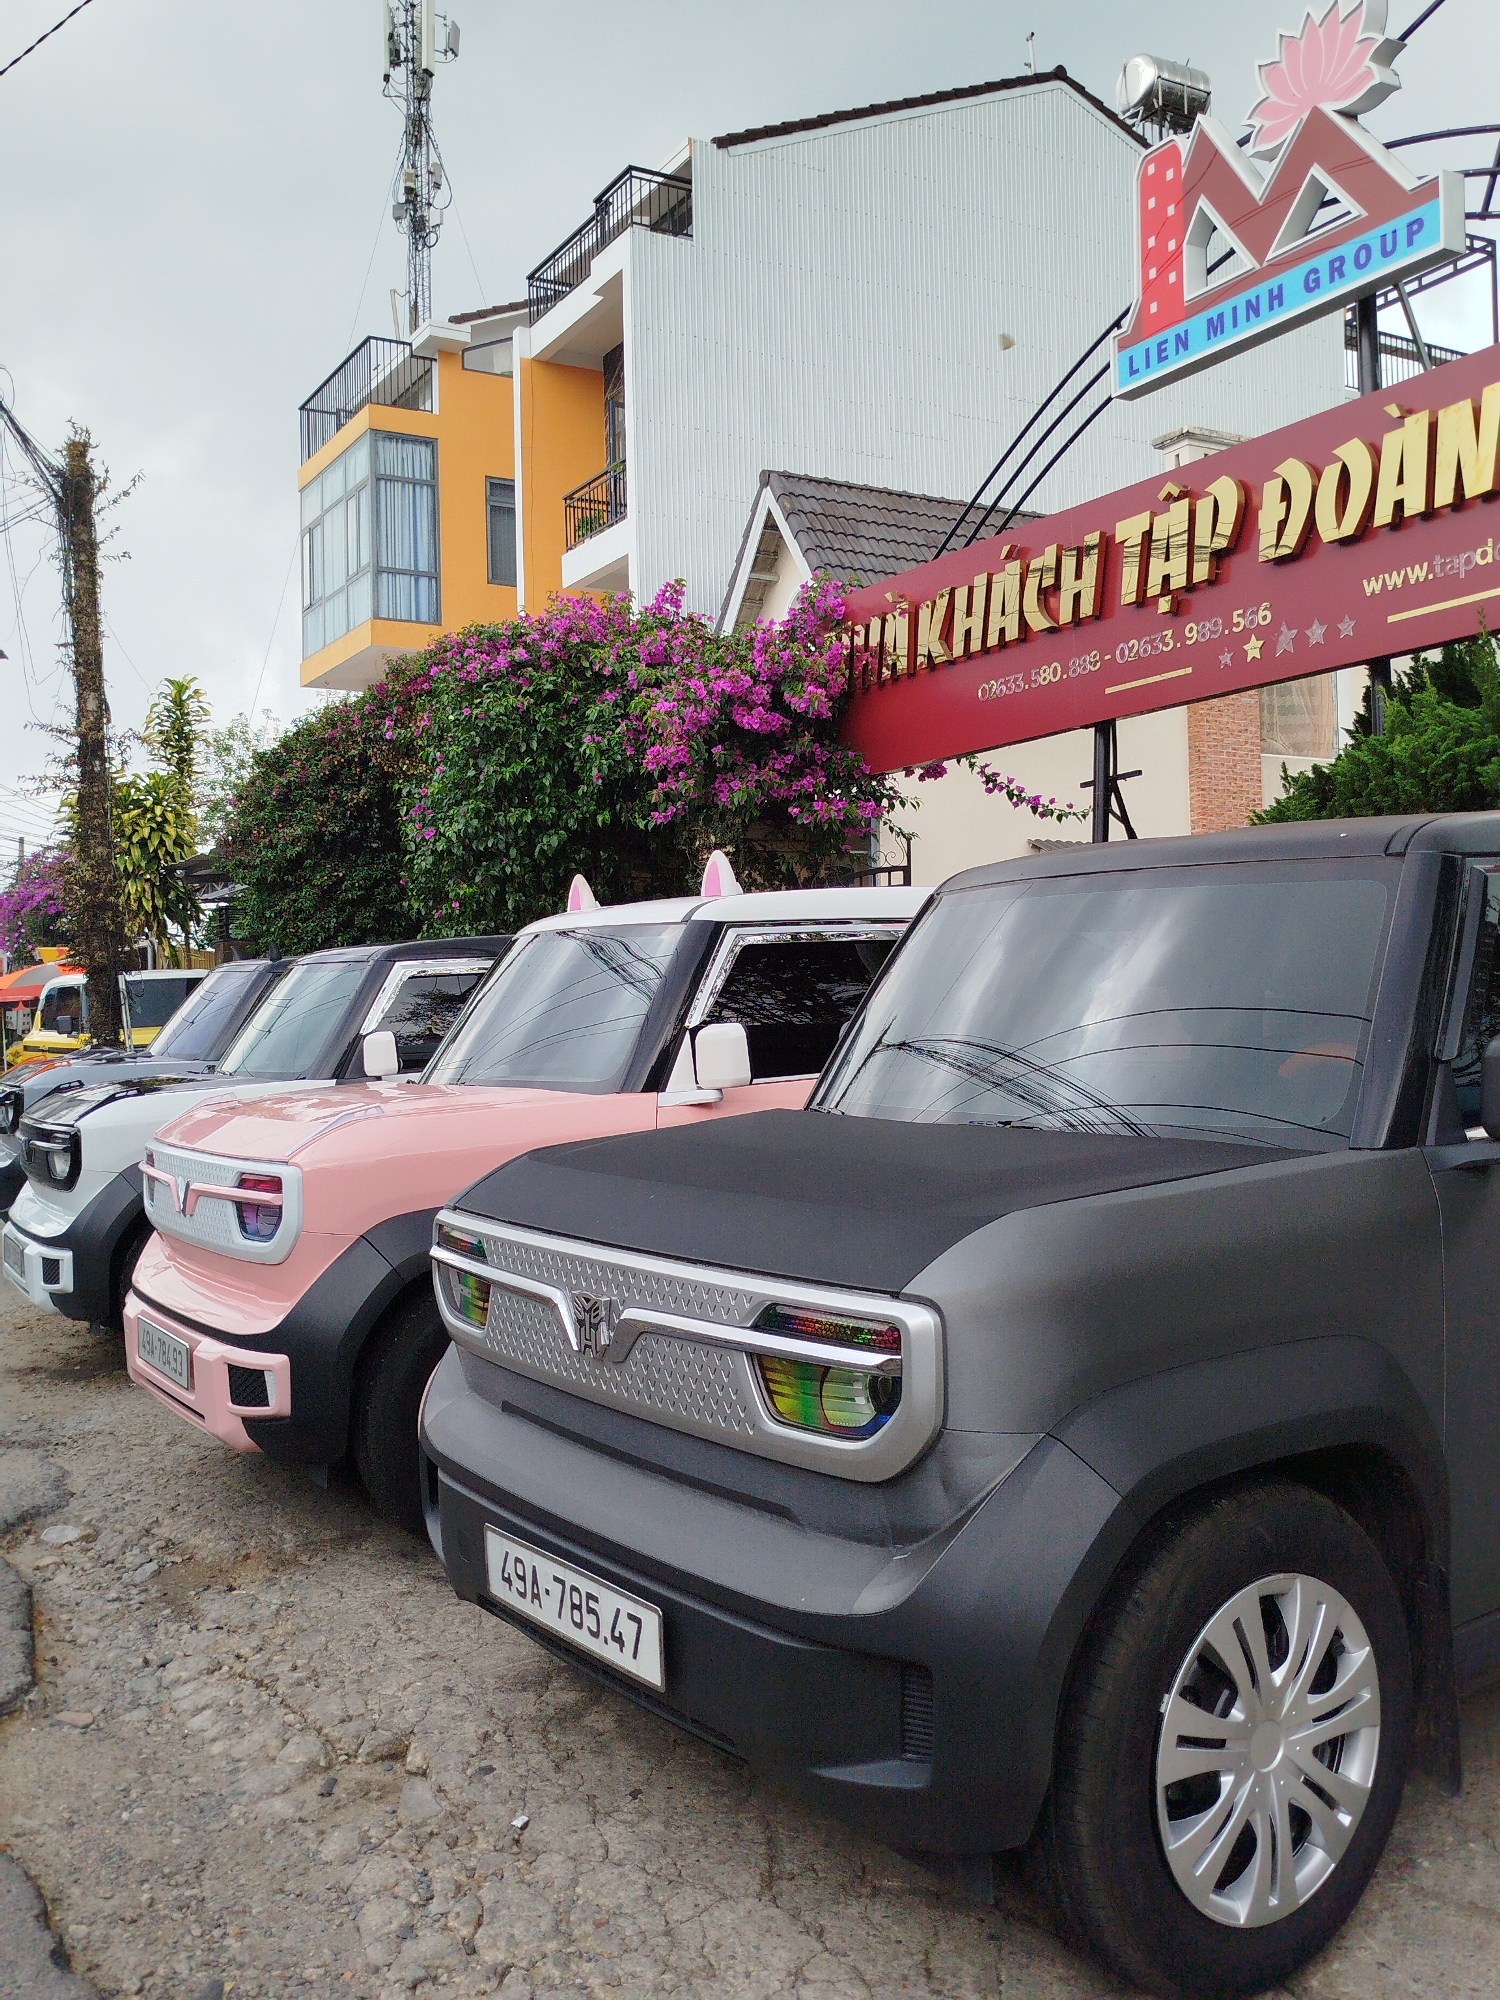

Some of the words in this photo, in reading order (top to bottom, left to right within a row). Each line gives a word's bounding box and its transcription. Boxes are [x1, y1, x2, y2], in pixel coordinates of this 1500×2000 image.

[1128, 329, 1189, 377] LIEN
[1206, 283, 1284, 340] MINH
[1303, 217, 1425, 293] GROUP
[917, 534, 1099, 669] KHÁCH
[1115, 474, 1240, 614] TẬP
[1258, 381, 1500, 563] ĐOÀN
[501, 1550, 643, 1661] 49A-785.47
